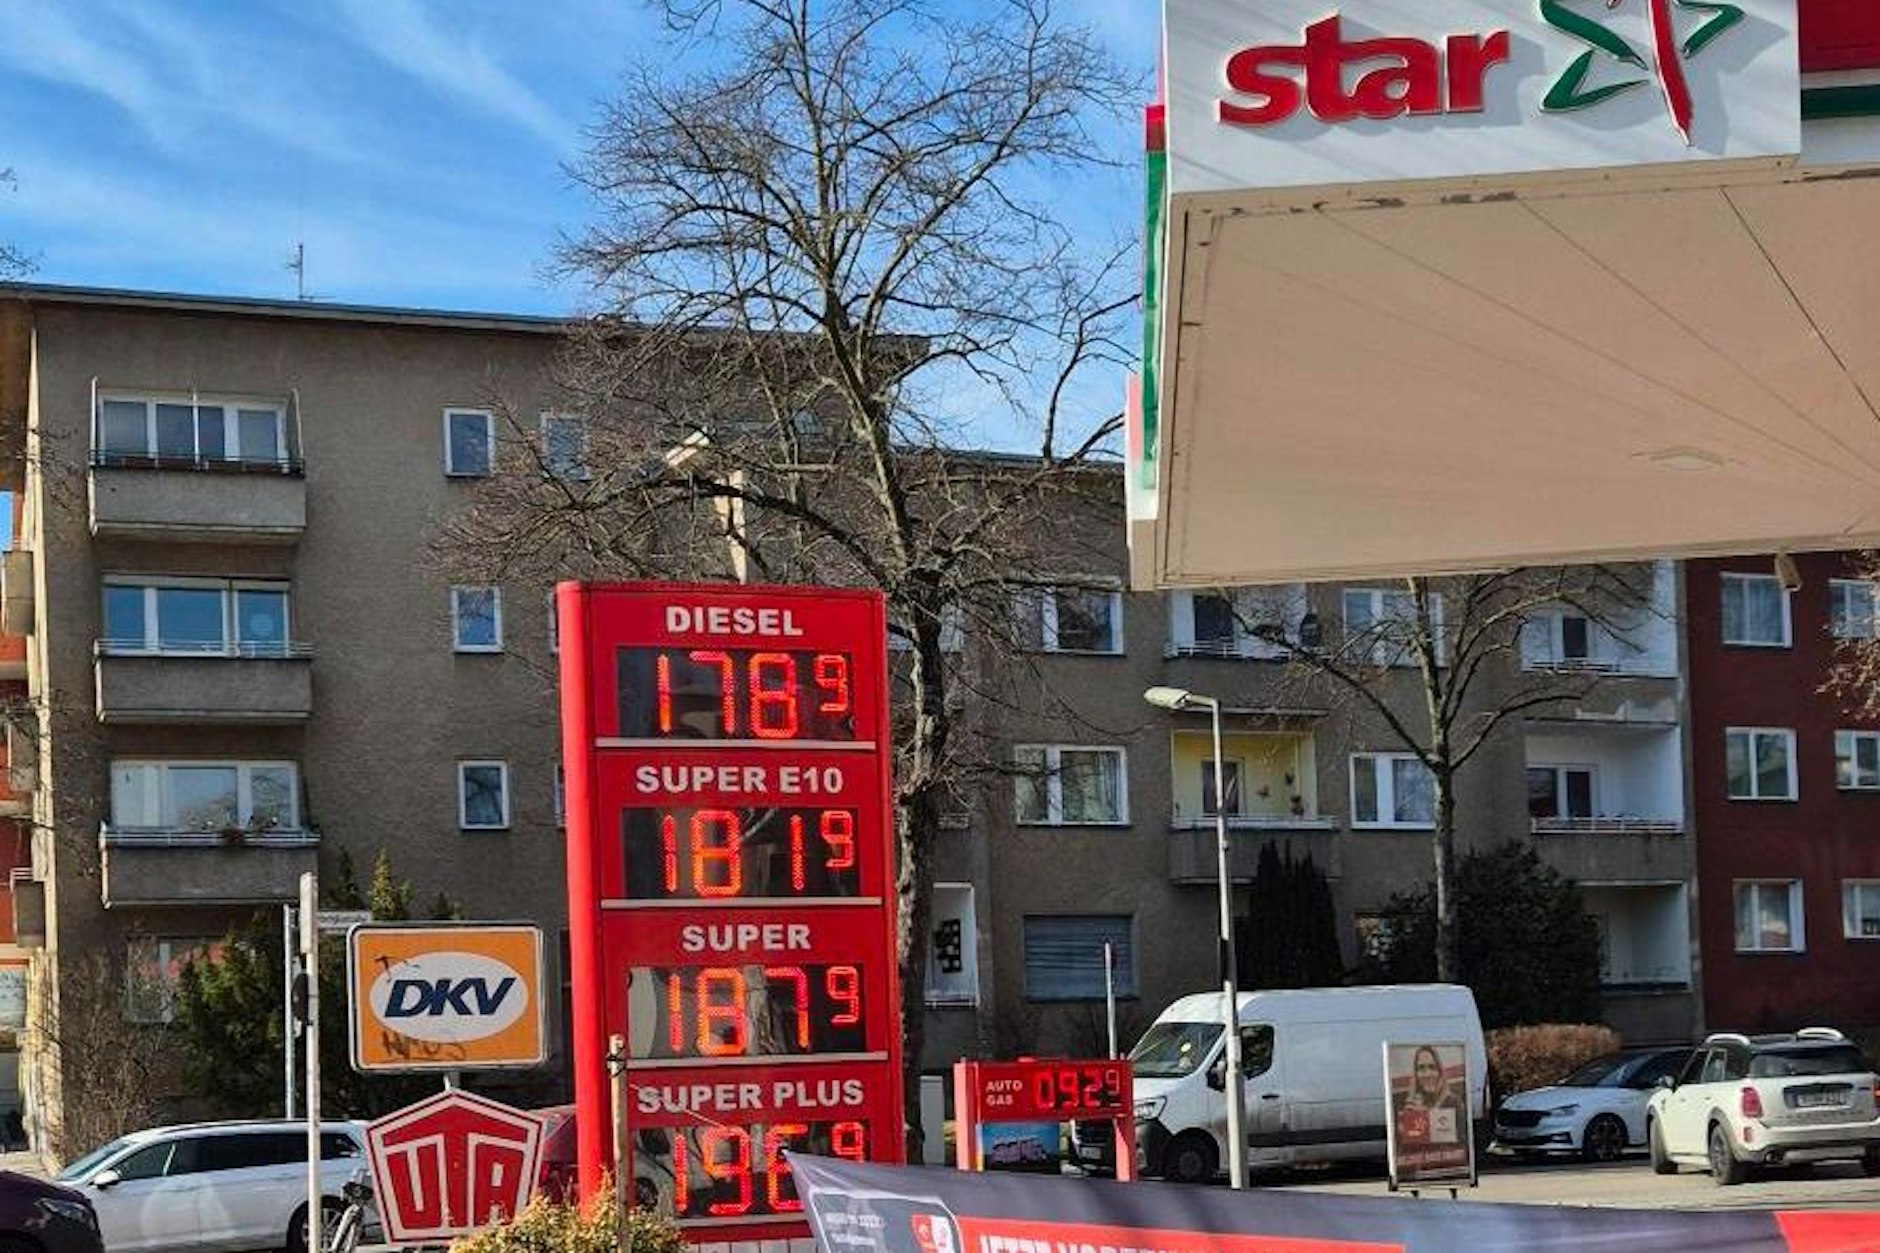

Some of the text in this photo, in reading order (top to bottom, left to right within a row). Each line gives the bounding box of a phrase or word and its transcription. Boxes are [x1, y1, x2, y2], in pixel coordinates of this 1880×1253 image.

[1219, 15, 1510, 126] star
[665, 606, 804, 636] DIESEL
[636, 766, 843, 793] SUPER E10
[682, 924, 811, 951] SUPER
[384, 978, 517, 1018] DKV
[638, 1079, 864, 1113] SUPER PLUS
[985, 1080, 1023, 1093] AUTO
[986, 1094, 1014, 1106] GAS
[382, 1105, 529, 1229] UTA
